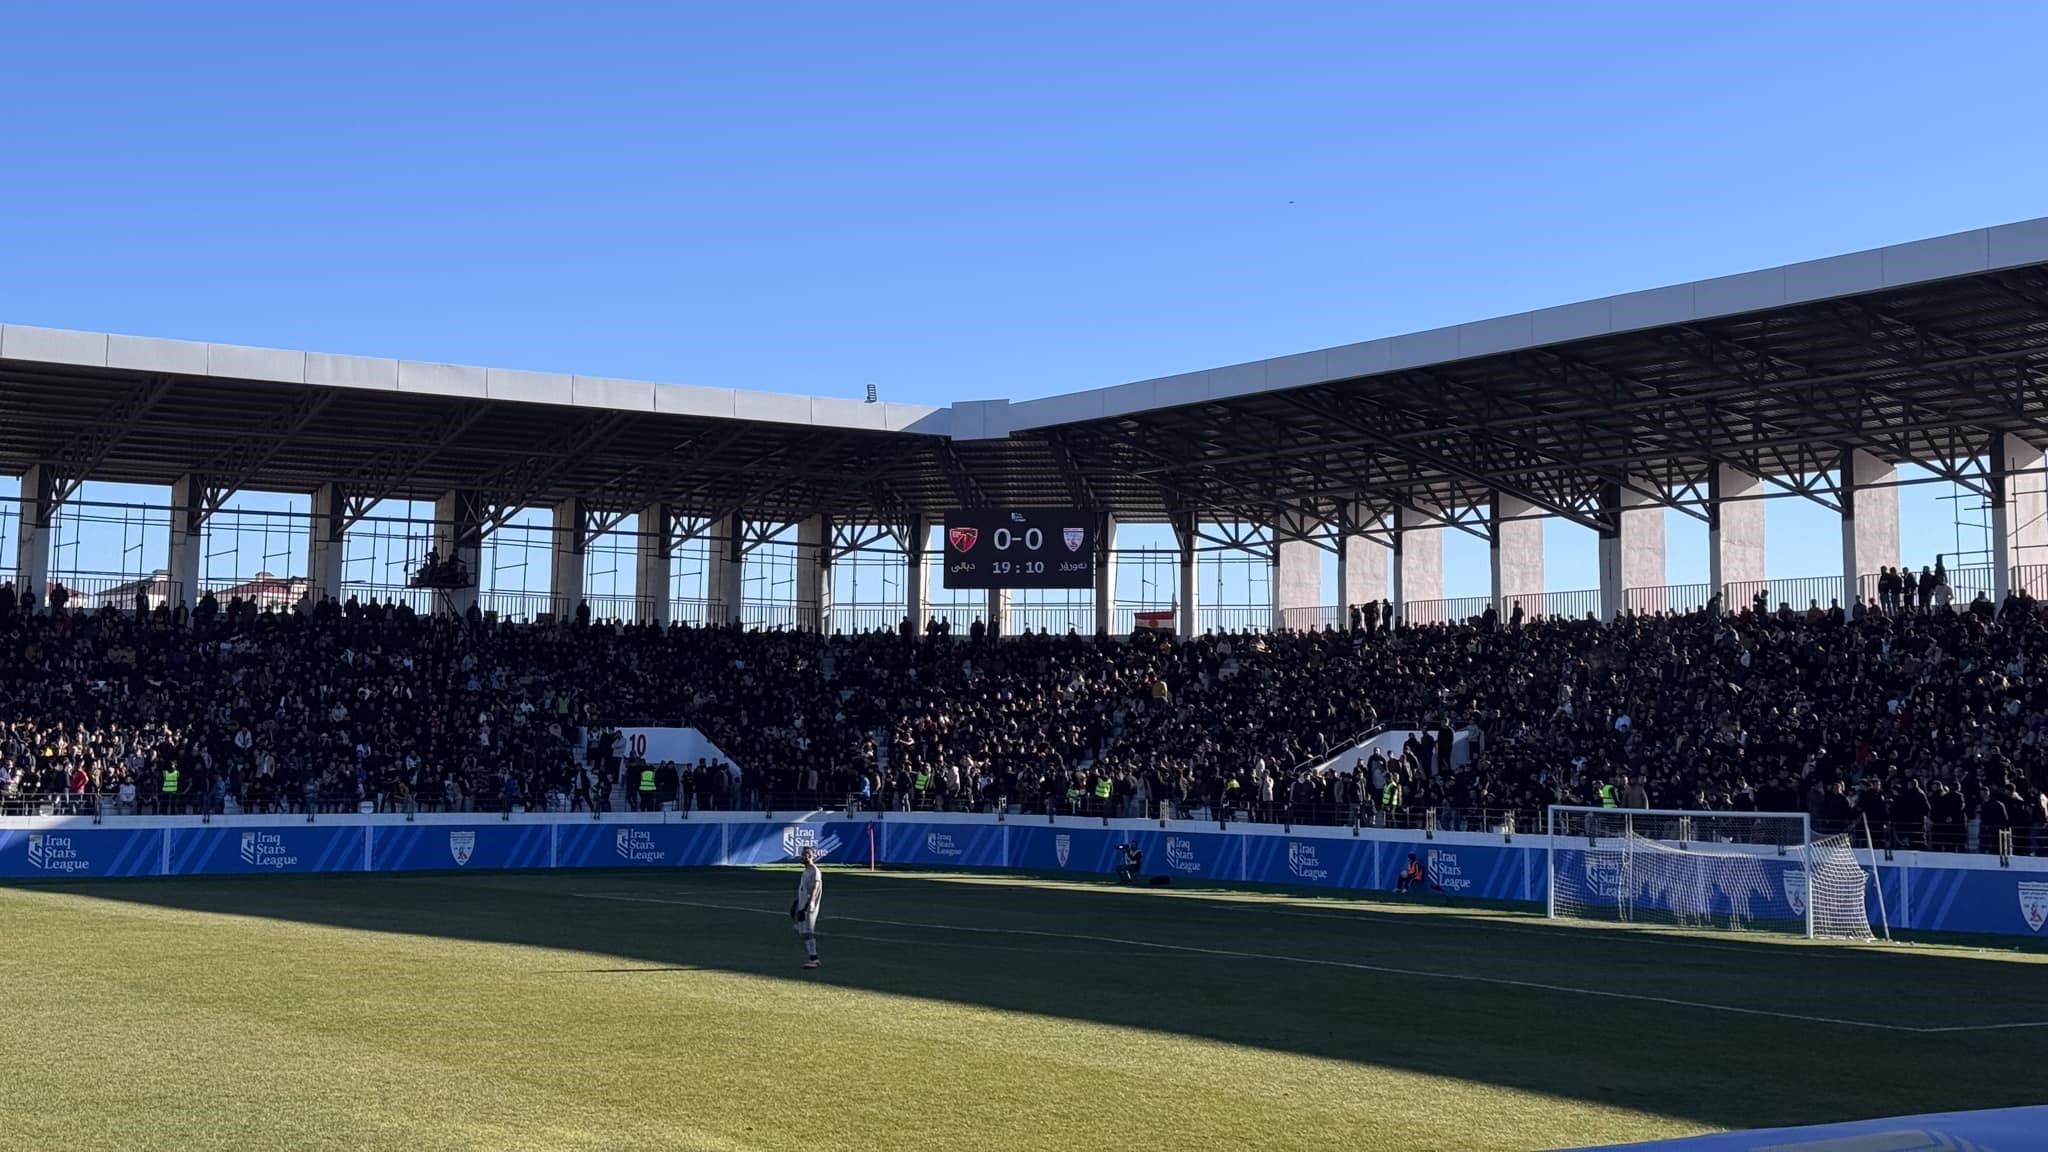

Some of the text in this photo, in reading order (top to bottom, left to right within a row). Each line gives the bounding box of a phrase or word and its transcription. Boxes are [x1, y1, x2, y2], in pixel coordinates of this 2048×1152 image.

[993, 527, 1043, 550] 0-0
[630, 734, 647, 758] 10
[256, 831, 280, 846] Iraq
[630, 828, 650, 841] Iraq
[795, 826, 814, 840] Iraq
[46, 834, 71, 849] Iraq
[256, 843, 287, 855] Stars
[629, 839, 655, 850] Stars
[795, 837, 819, 847] Stars
[1176, 836, 1190, 851] Iraq
[44, 846, 77, 858] Stars
[629, 848, 665, 863] League
[1175, 848, 1194, 860] Stars
[1299, 842, 1315, 858] Iraq
[1439, 849, 1457, 866] Iraq
[44, 857, 89, 873] League
[256, 855, 298, 869] League
[1175, 858, 1201, 873] League
[1299, 854, 1320, 867] Stars
[1299, 864, 1328, 881] League
[1439, 862, 1462, 875] Stars
[1439, 873, 1471, 892] League
